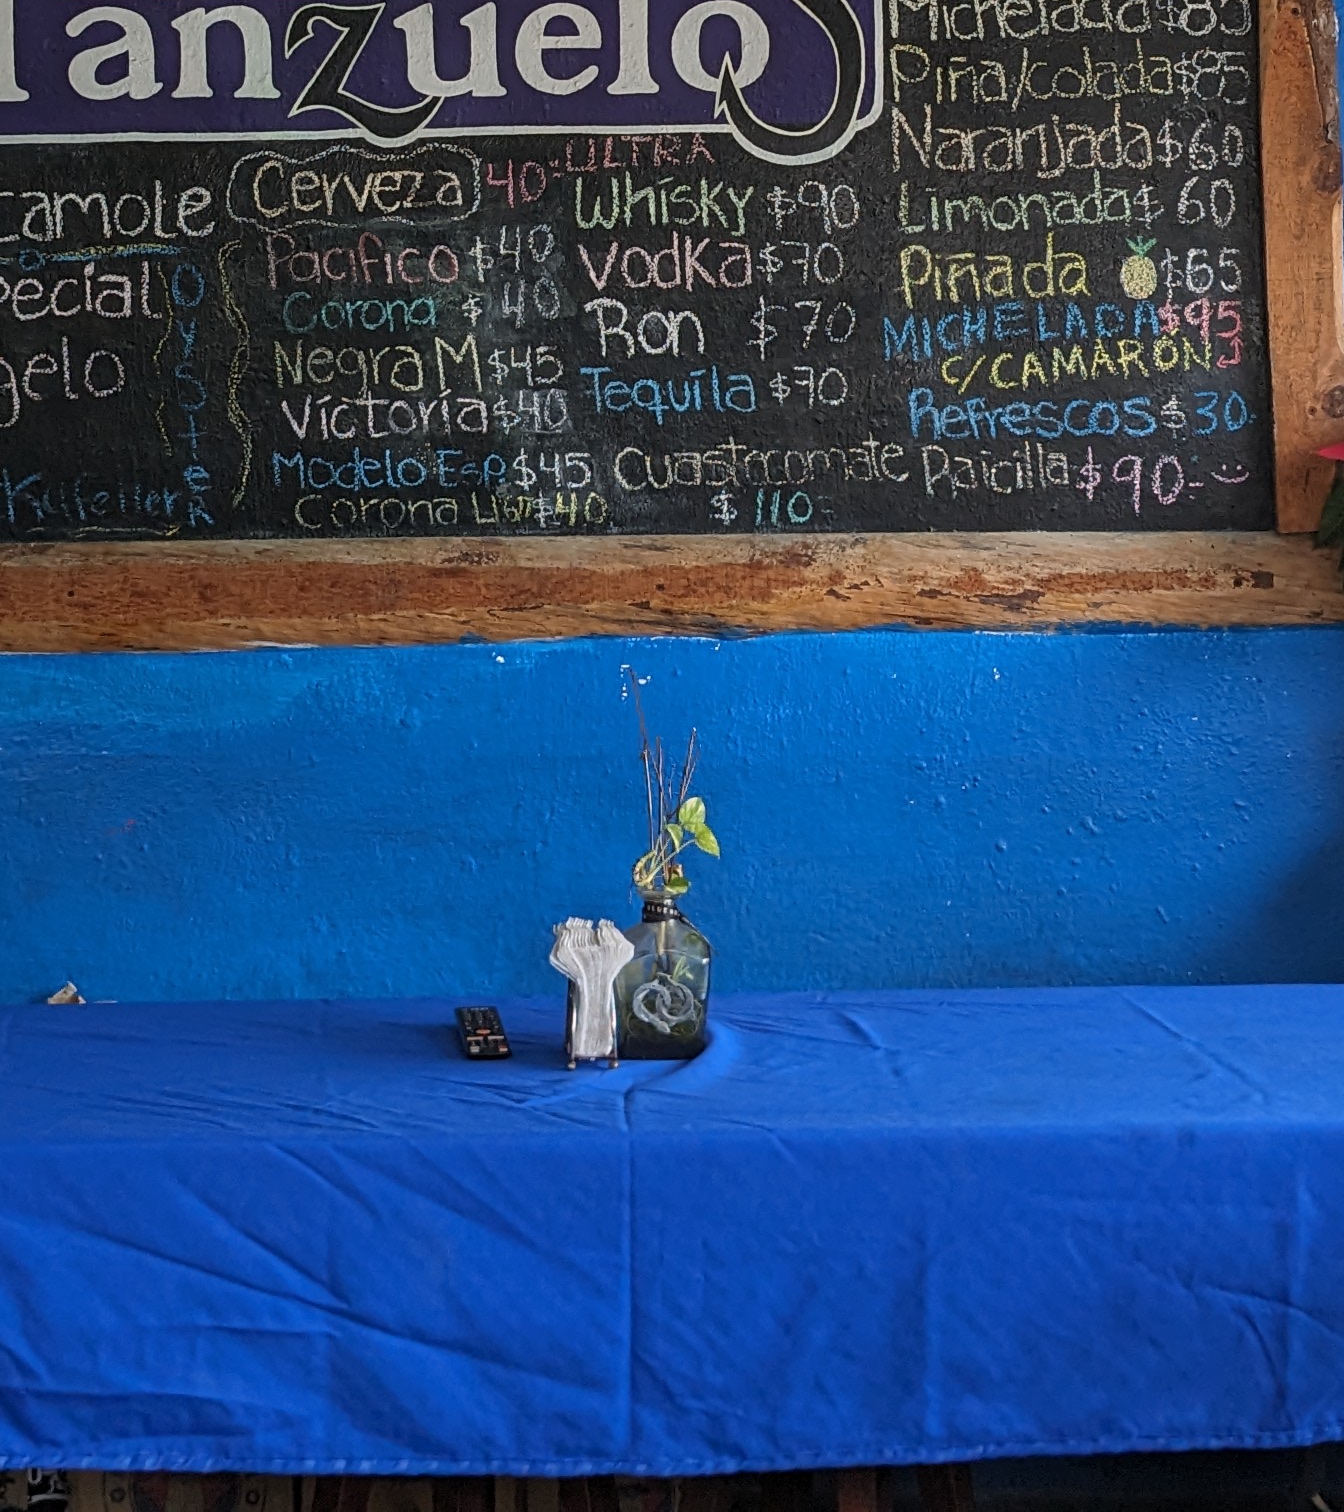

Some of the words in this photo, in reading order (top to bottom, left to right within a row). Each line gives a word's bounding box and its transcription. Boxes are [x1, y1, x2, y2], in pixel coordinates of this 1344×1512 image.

[1174, 46, 1251, 105] $85
[565, 133, 716, 172] ULTRA
[891, 101, 1153, 179] Naranjada
[1156, 118, 1244, 172] $60
[253, 159, 463, 219] Cerveza
[574, 171, 754, 237] Whisky
[767, 180, 860, 235] $90
[898, 168, 1131, 234] Limonada
[263, 231, 460, 291] Pacifico
[468, 224, 555, 282] $40
[578, 231, 753, 291] Vodka
[757, 241, 845, 286] $70
[897, 230, 1091, 309] Piñada
[1161, 246, 1242, 300] $65
[282, 291, 438, 334] Corona
[583, 297, 705, 359] Ron
[882, 300, 1158, 362] MICHELADA
[1157, 297, 1244, 341] $95
[434, 334, 483, 392] M
[488, 344, 564, 387] $45
[281, 390, 489, 440] Victoria
[579, 365, 757, 427] Tequila
[769, 365, 850, 409] $70
[271, 446, 428, 491] Modelo
[513, 448, 592, 491] $45
[294, 492, 458, 530] Corona
